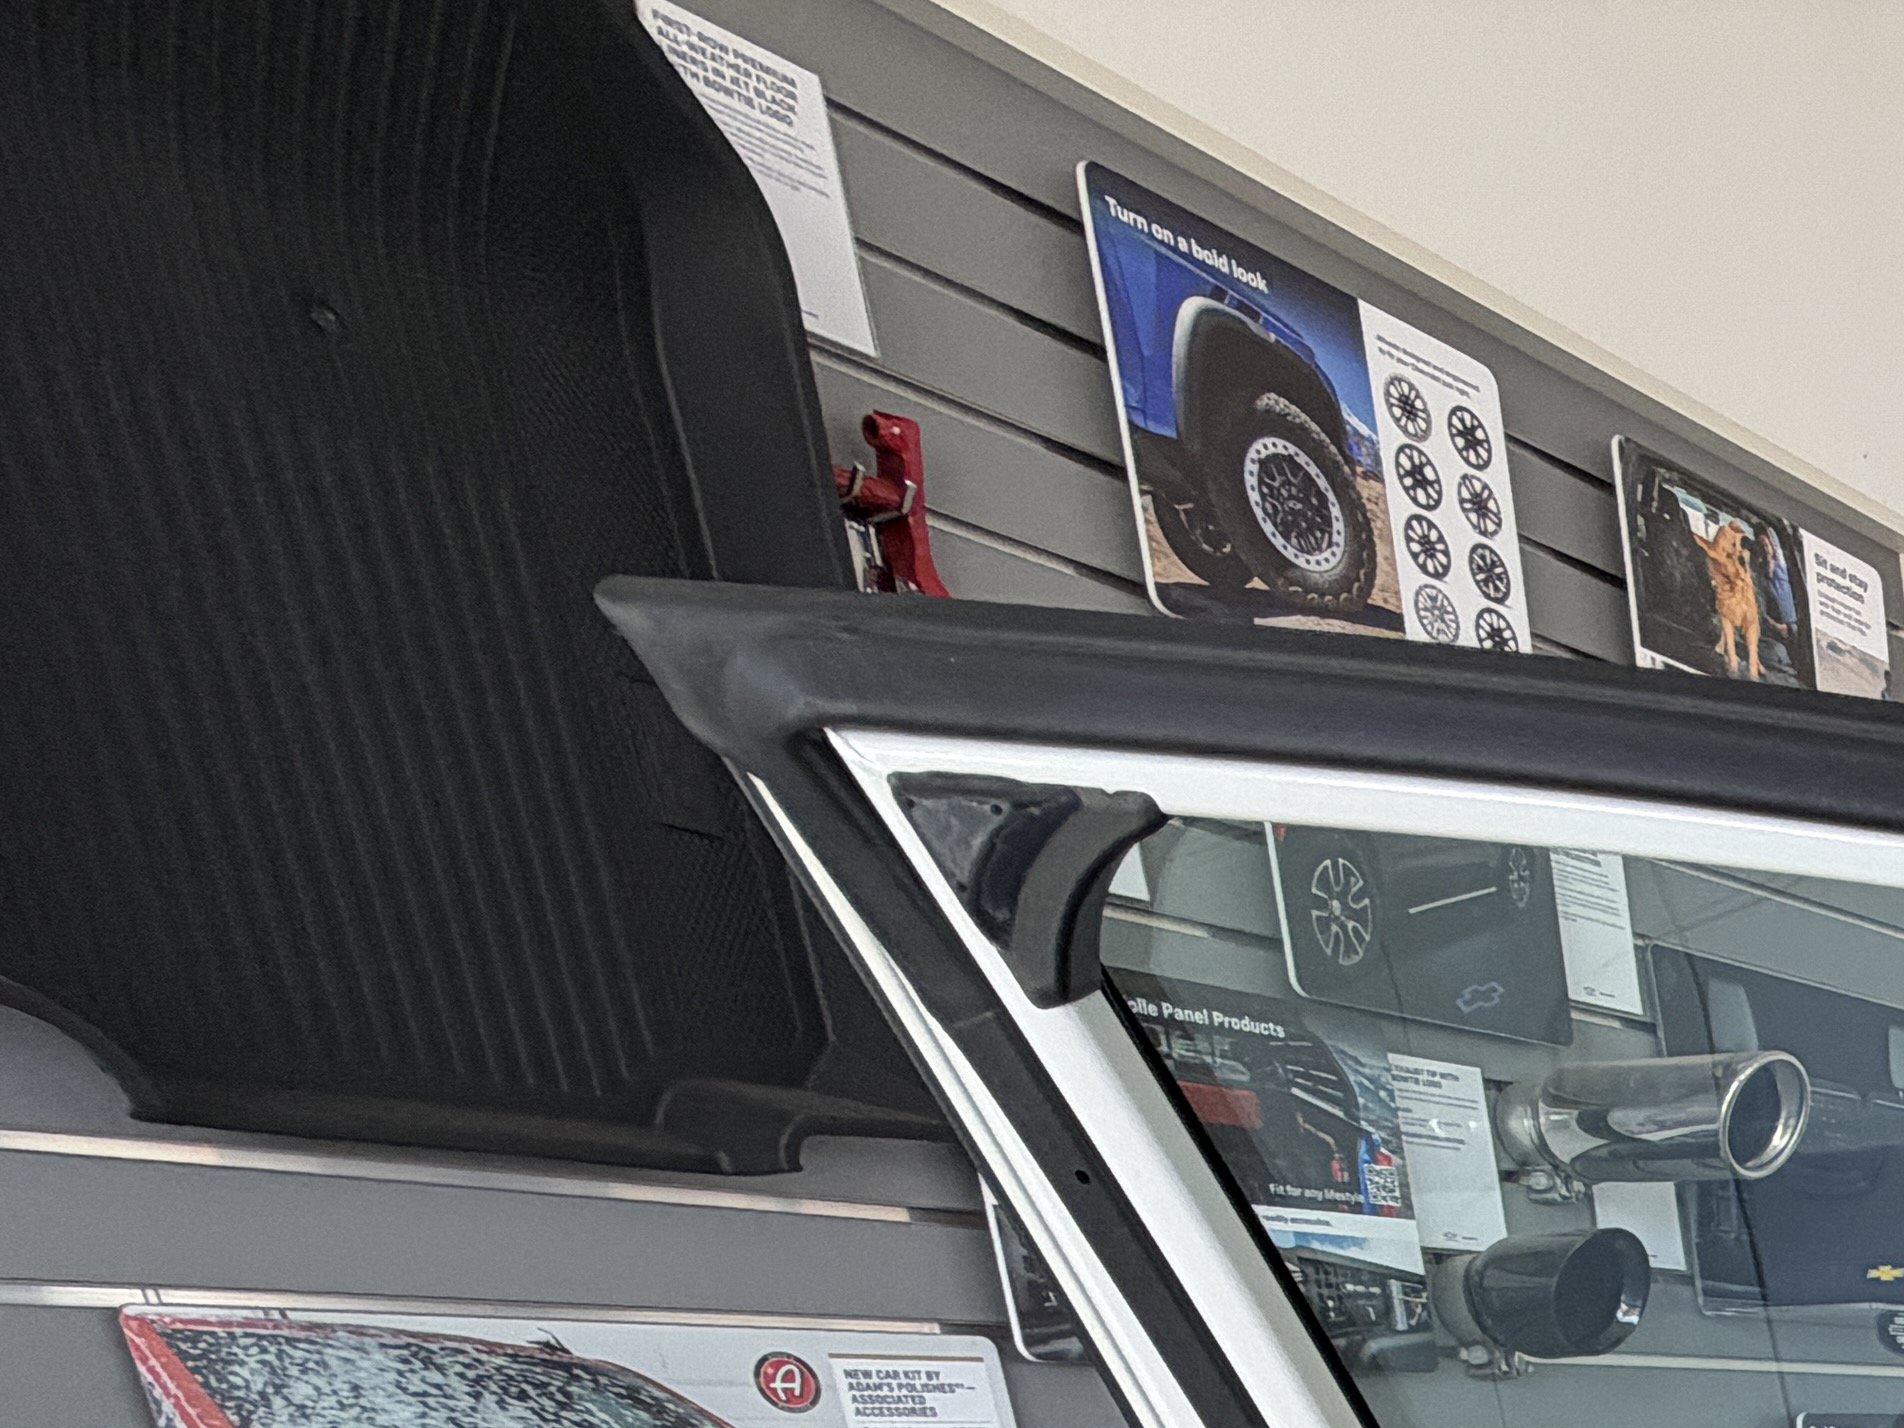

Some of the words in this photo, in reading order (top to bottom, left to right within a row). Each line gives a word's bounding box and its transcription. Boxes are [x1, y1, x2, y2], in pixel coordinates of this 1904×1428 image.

[1104, 195, 1149, 234] Turn
[1151, 223, 1175, 247] on
[1177, 236, 1190, 254] a
[1190, 238, 1229, 275] bold
[1231, 259, 1270, 294] look
[1127, 996, 1159, 1017] olle
[1161, 1001, 1209, 1025] Panel
[1211, 1010, 1286, 1039] Products
[1269, 1183, 1286, 1196] Fit
[1286, 1184, 1302, 1197] for
[843, 1369, 873, 1380] NEW
[875, 1369, 902, 1381] CAR
[903, 1370, 923, 1381] KIT
[924, 1371, 941, 1381] BY
[848, 1382, 895, 1393] ADAM'S
[851, 1394, 927, 1405] ASSOCIATED
[854, 1406, 938, 1418] ACCESSORIES
